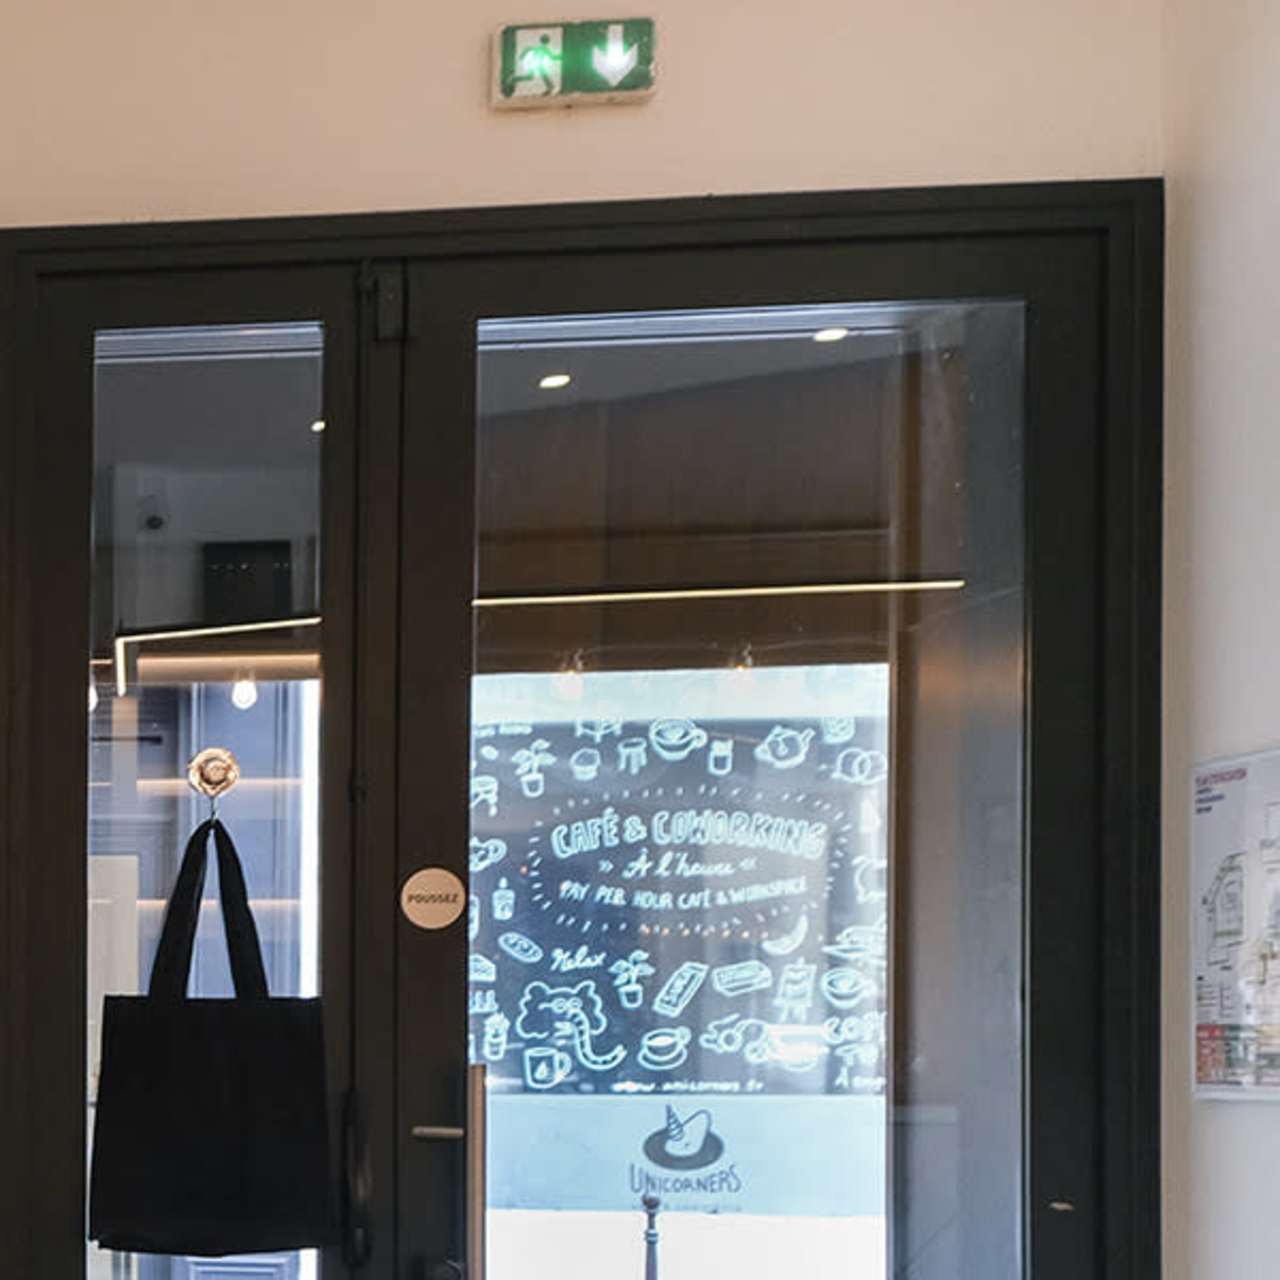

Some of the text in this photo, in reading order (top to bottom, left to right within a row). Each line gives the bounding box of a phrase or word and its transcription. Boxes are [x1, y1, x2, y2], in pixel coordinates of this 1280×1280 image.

[551, 806, 828, 860] CAFÉ & COWORKING
[407, 893, 459, 905] POUSSEZ
[559, 880, 590, 900] PAY
[594, 885, 627, 906] PER
[632, 890, 674, 909] HOUR
[629, 1163, 741, 1195] UNICORNERS
